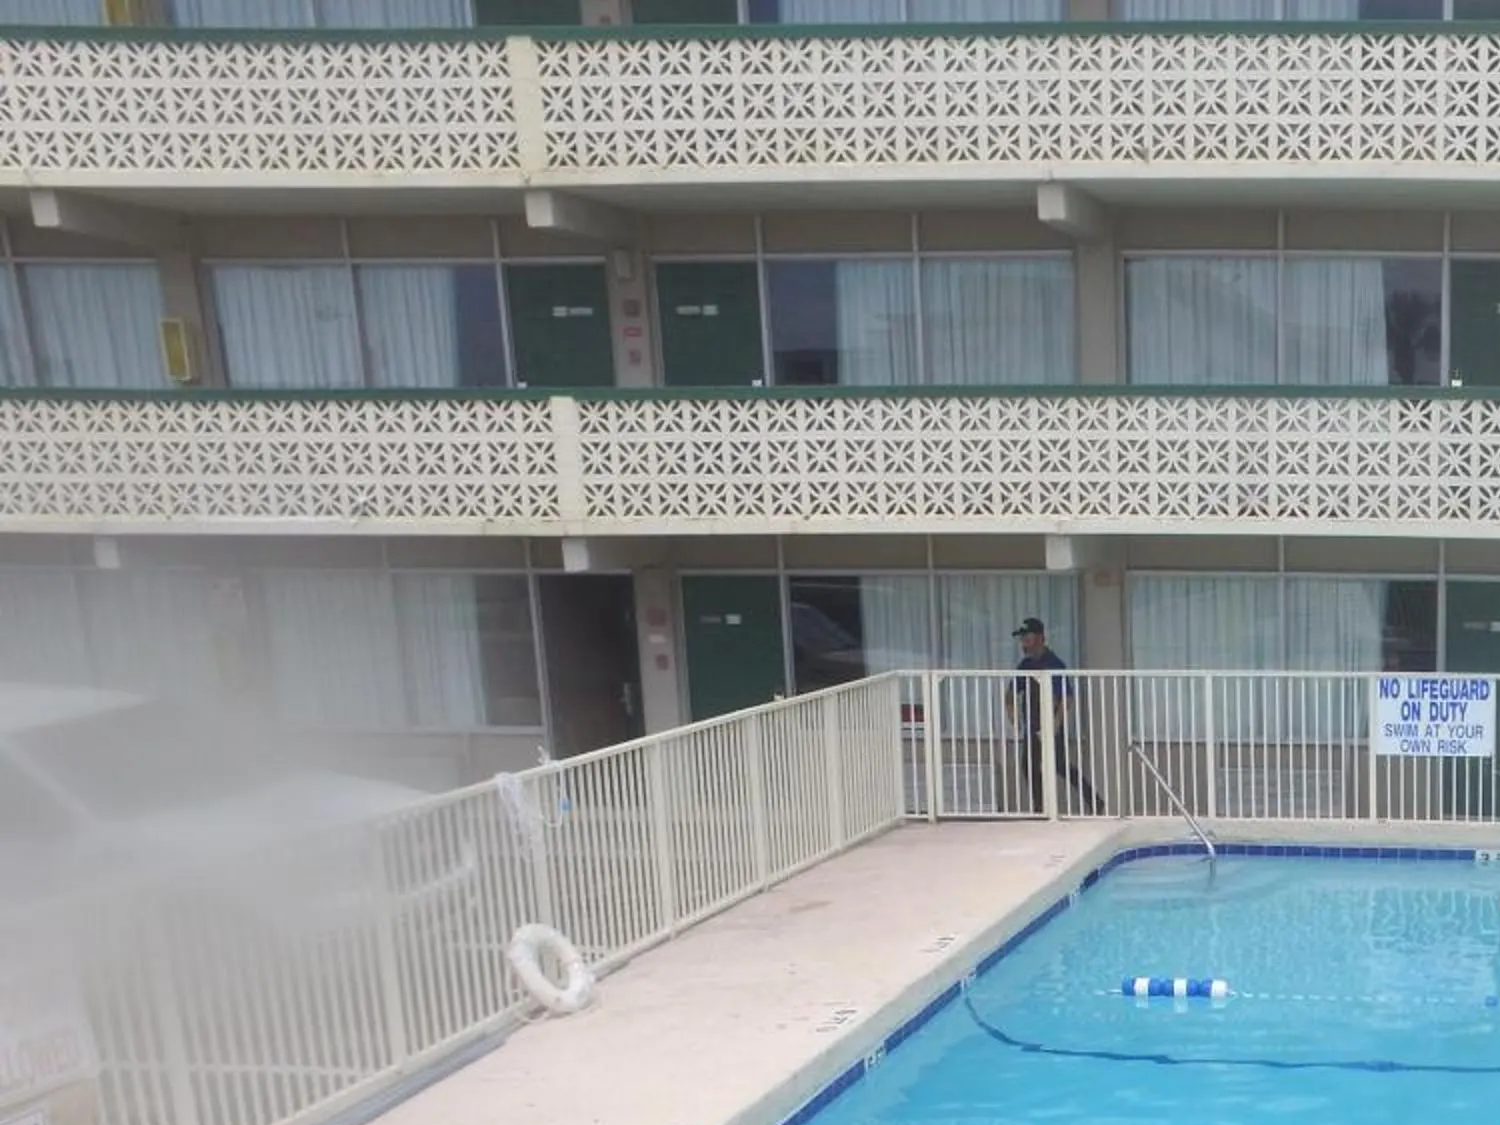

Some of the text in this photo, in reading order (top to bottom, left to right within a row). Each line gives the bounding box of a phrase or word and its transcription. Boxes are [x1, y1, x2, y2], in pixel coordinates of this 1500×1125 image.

[1379, 678, 1490, 701] NO LIFEGUARD
[1401, 701, 1468, 722] ON DUTY
[1383, 723, 1484, 739] SWIM AT YOUR
[1400, 739, 1468, 754] OWN RISK
